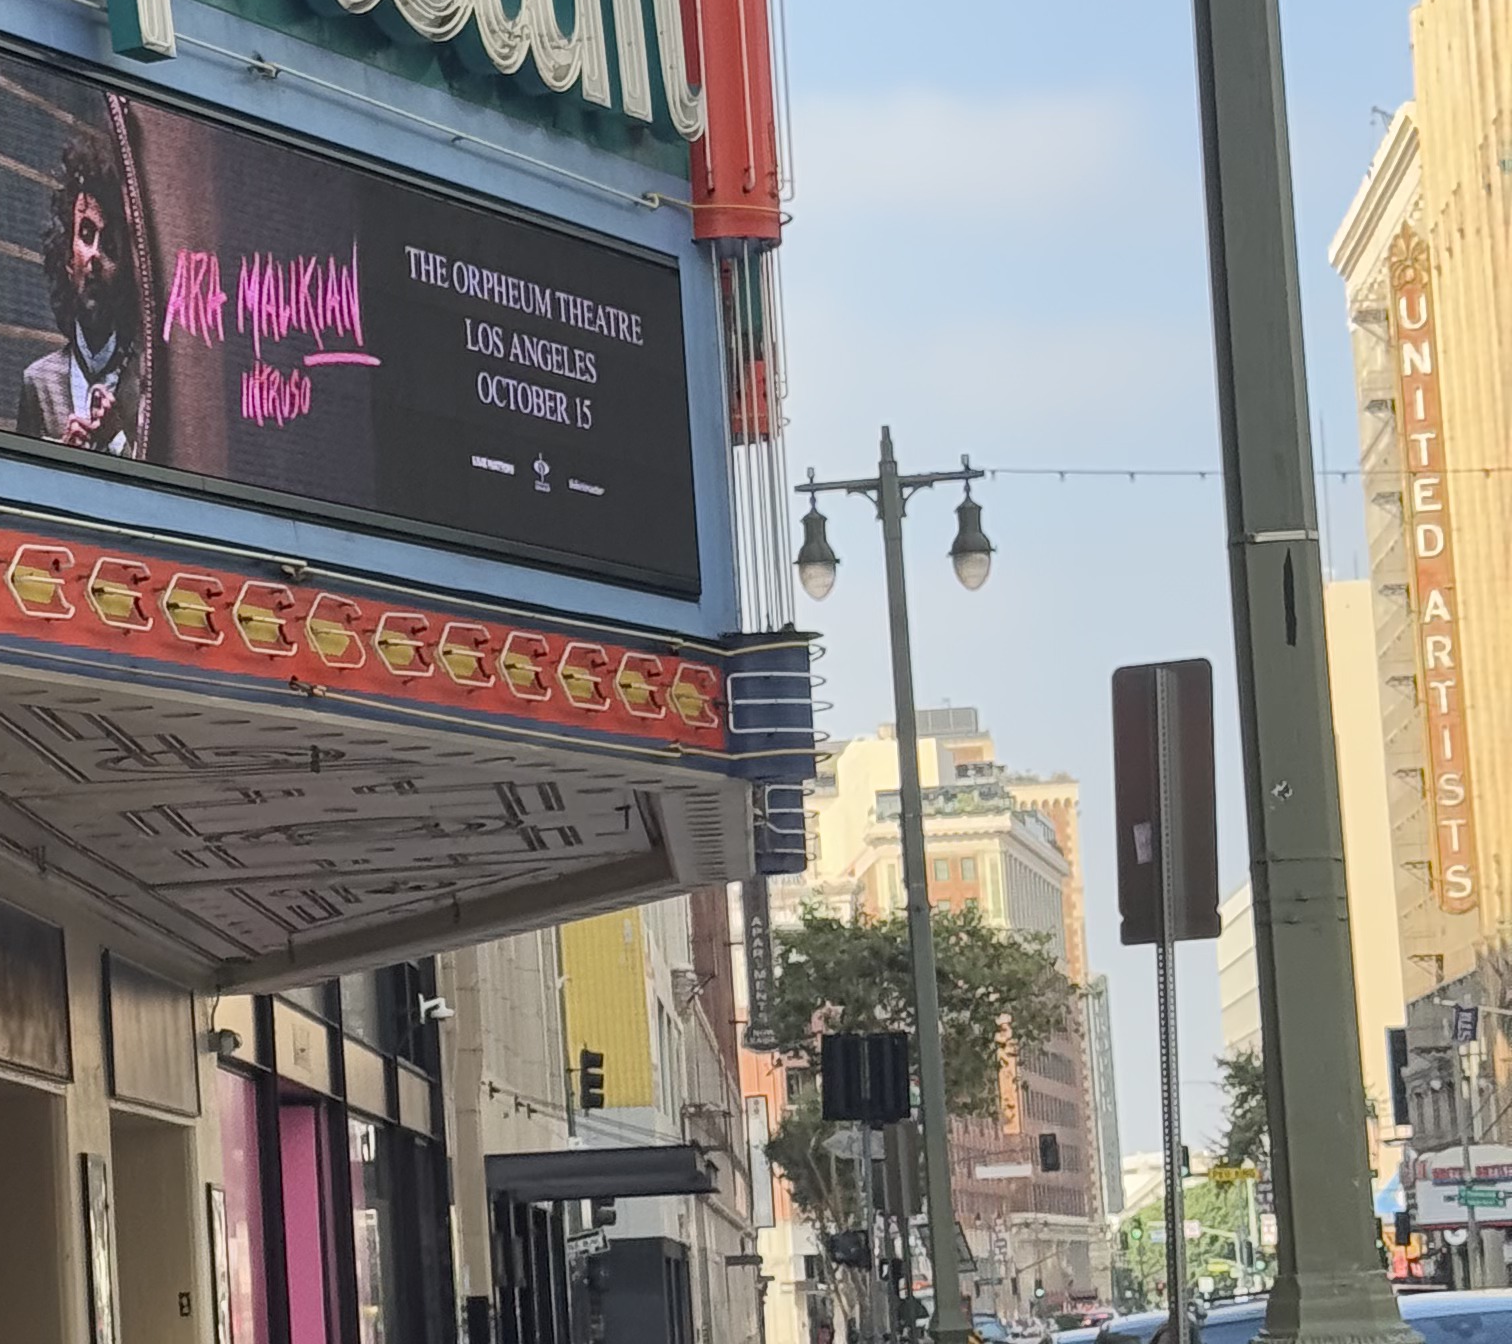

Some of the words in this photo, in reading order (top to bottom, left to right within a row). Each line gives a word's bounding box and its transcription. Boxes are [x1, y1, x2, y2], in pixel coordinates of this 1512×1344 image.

[163, 248, 228, 348] ARA
[236, 236, 364, 356] MALIKIAN
[405, 245, 449, 288] THE
[452, 262, 552, 320] ORPHEUM
[556, 291, 644, 346] THEATRE
[240, 362, 312, 427] INTRUSO
[464, 318, 504, 358] LOS
[509, 333, 598, 384] ANGELES
[476, 372, 570, 424] OCTOBER
[575, 400, 593, 430] 15
[1399, 291, 1445, 560] UNITED
[1421, 586, 1474, 901] ARTISTS
